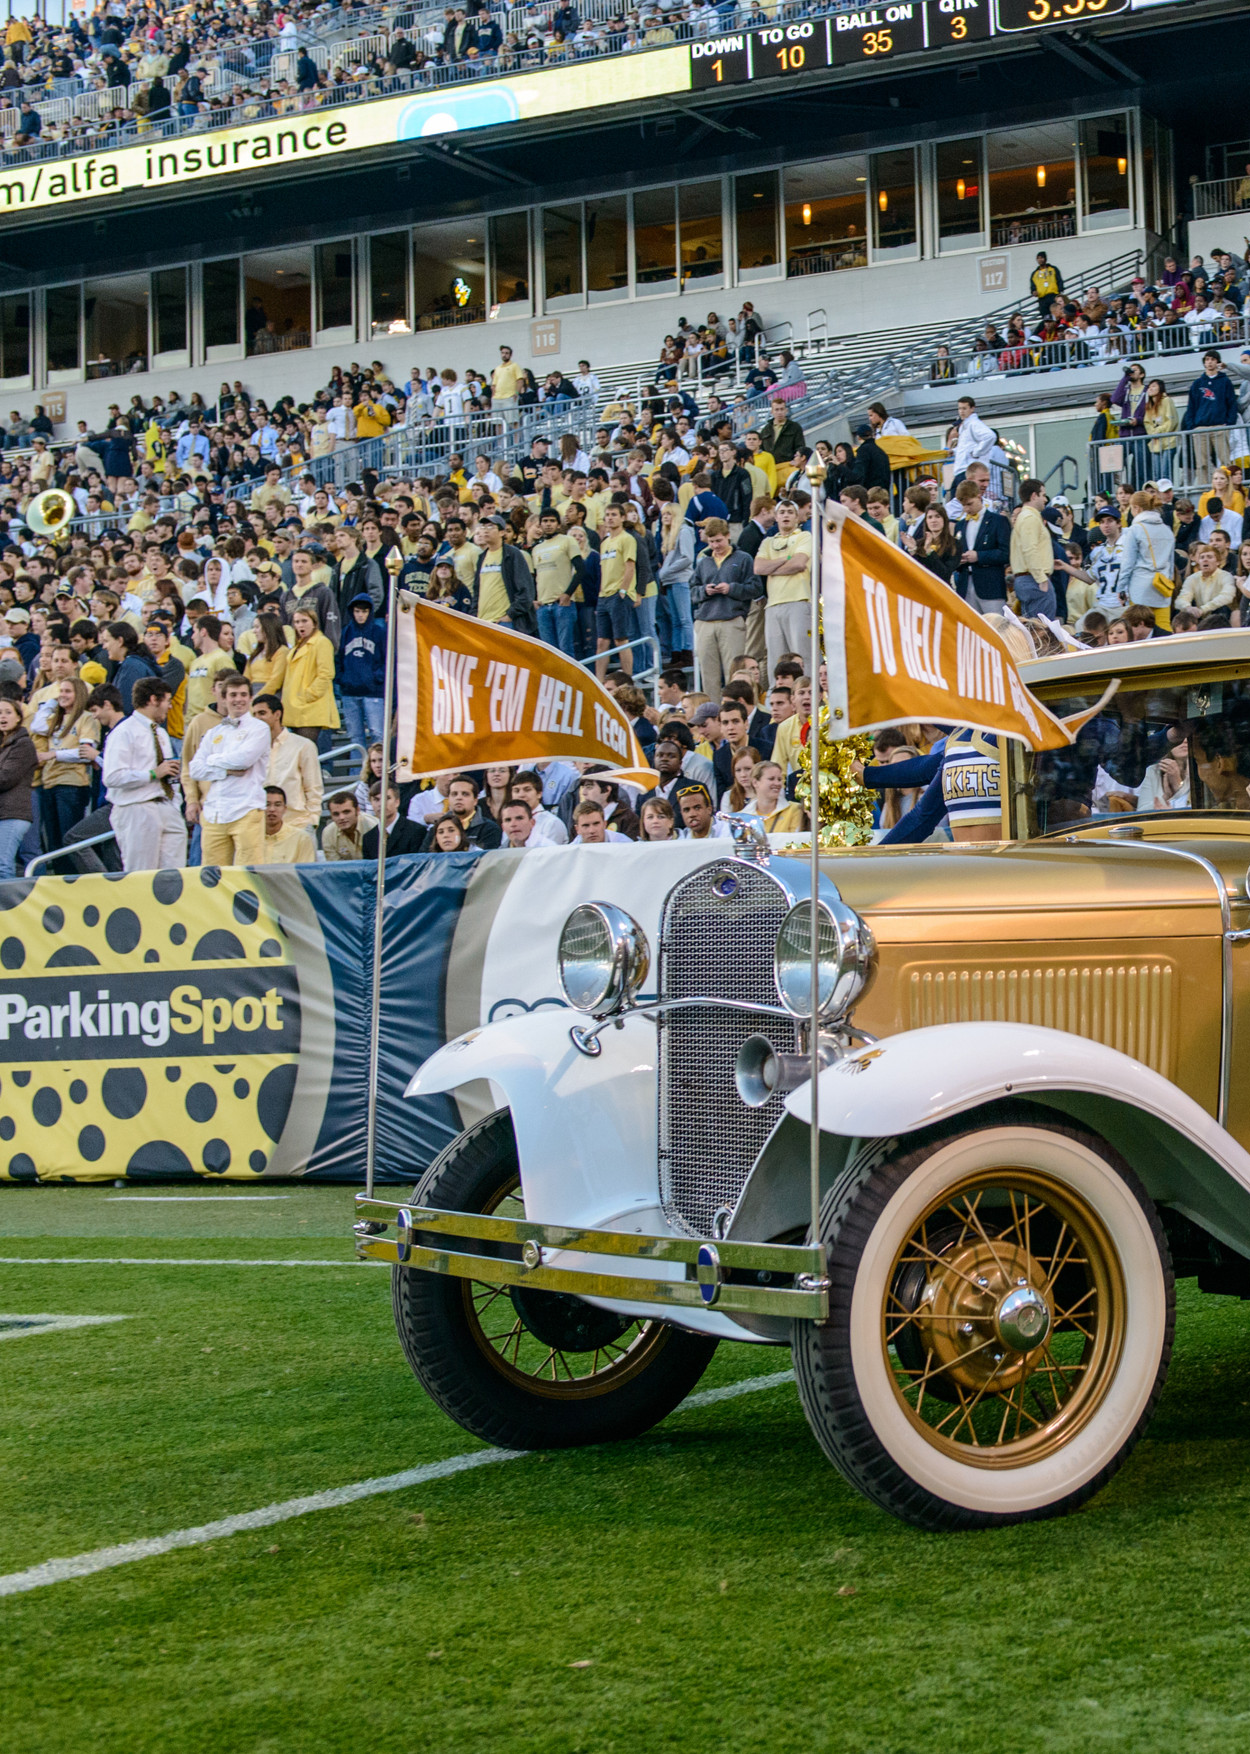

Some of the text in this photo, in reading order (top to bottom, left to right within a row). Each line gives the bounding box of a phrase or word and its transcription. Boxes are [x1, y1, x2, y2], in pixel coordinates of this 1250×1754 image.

[836, 3, 913, 32] BALL ON
[950, 15, 968, 39] 3
[691, 34, 744, 58] DOWN
[758, 22, 814, 45] TO GO
[862, 29, 893, 55] 35
[776, 45, 805, 70] 10
[711, 60, 722, 81] 1
[146, 121, 347, 179] insurance
[984, 271, 1003, 287] 117
[535, 333, 556, 348] 116
[862, 574, 898, 677] TO
[897, 594, 949, 691] HELL
[956, 621, 1006, 706] WITH
[430, 645, 628, 759] GIVE 'EM HELL TECH
[0, 985, 283, 1047] ParkingSpot
